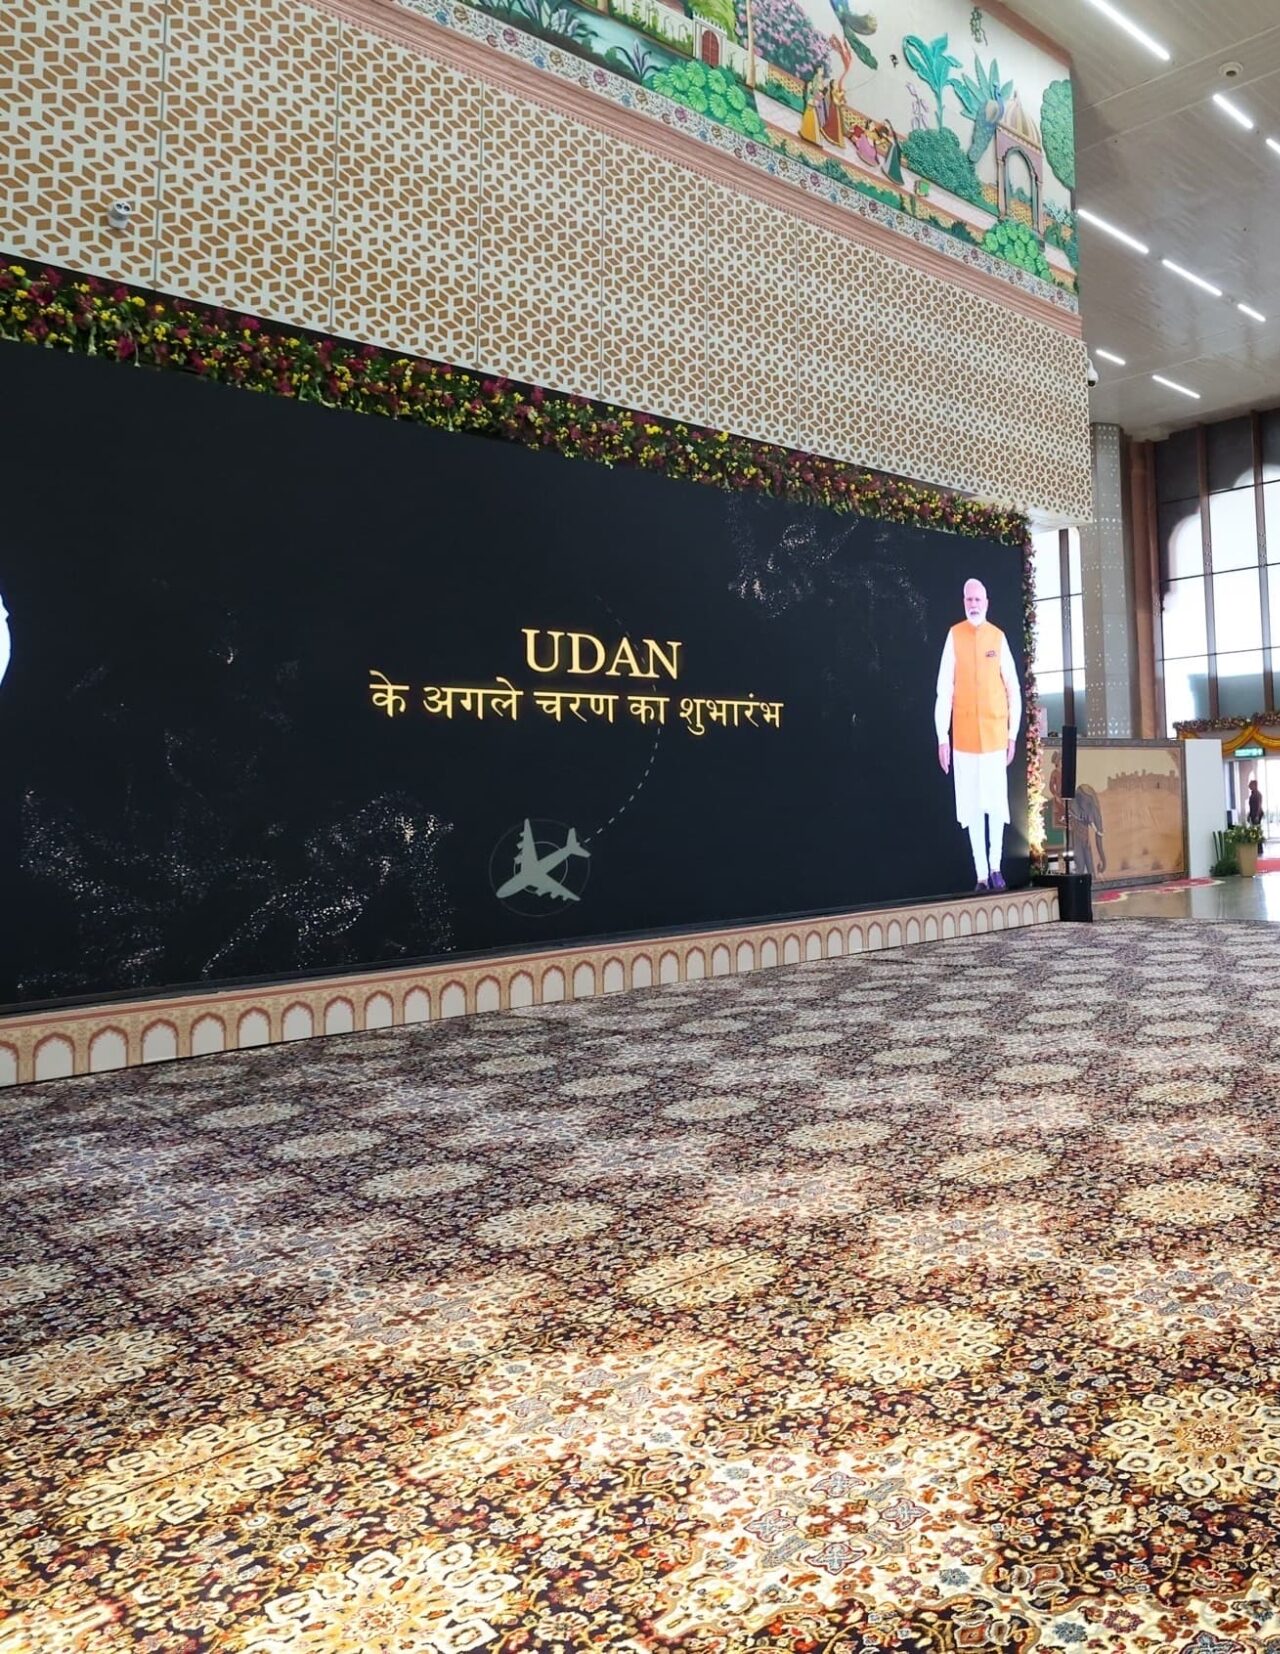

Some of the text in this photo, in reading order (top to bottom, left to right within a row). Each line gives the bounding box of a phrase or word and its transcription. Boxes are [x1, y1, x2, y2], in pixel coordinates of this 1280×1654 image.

[521, 628, 682, 680] UDAN
[369, 670, 784, 736] के अगले चरण का शुभारंभ
